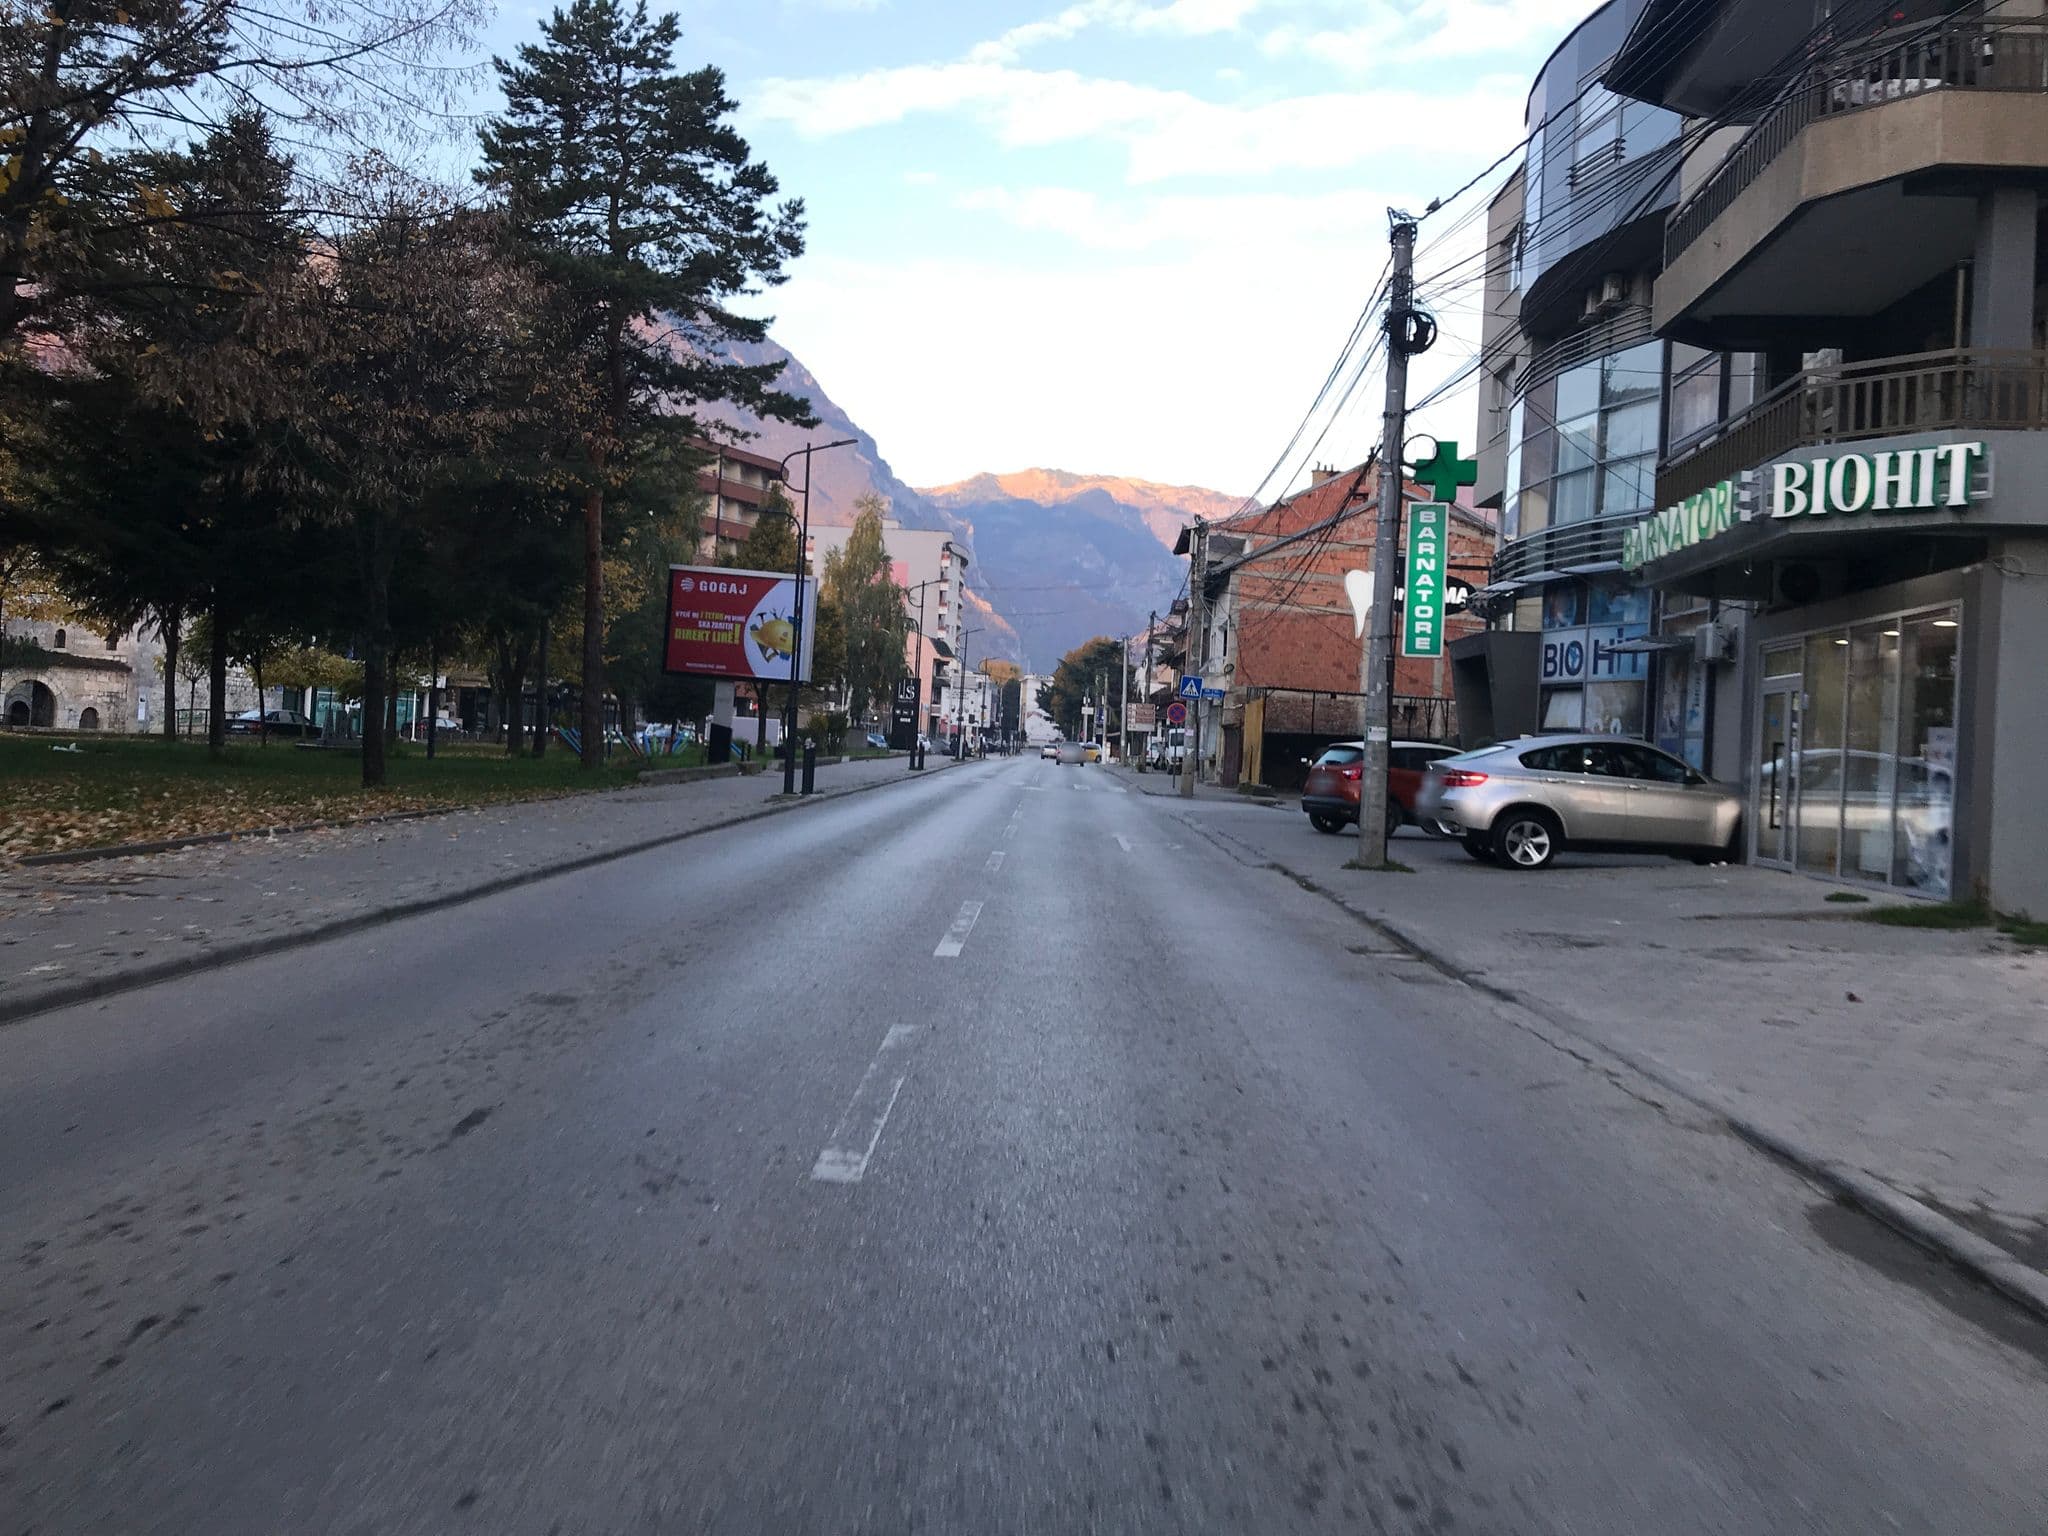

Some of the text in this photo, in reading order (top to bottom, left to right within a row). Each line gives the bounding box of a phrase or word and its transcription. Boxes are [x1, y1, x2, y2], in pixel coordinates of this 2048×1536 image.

[1770, 442, 1983, 517] BIOHIT
[1622, 471, 1752, 571] BARNATORE
[699, 580, 748, 595] GOGAJ
[1414, 511, 1437, 649] BARNATORE
[1543, 640, 1584, 678] BIO
